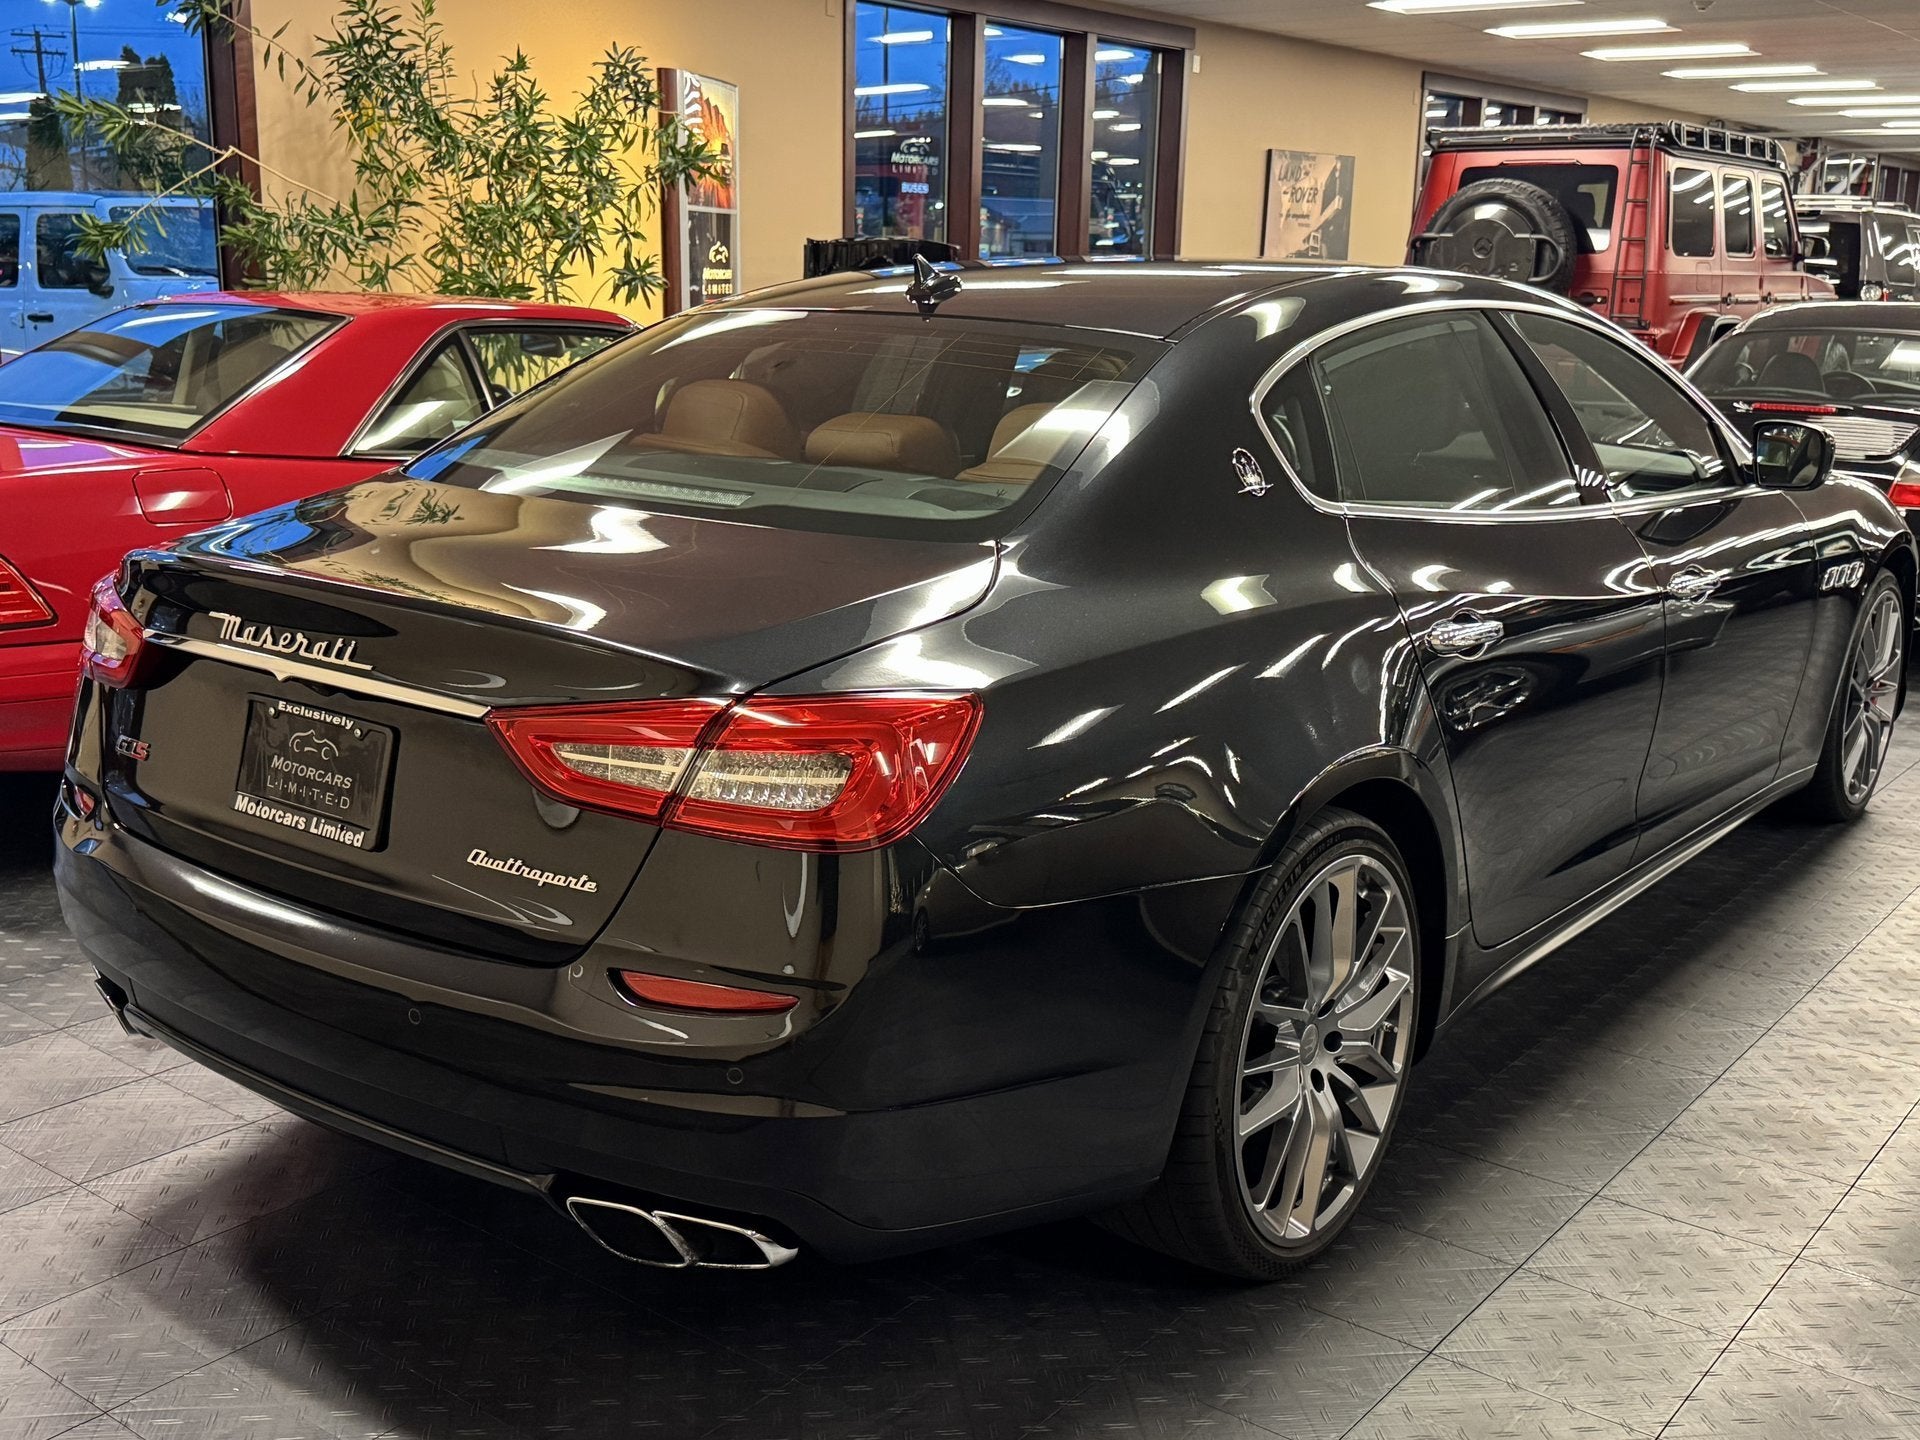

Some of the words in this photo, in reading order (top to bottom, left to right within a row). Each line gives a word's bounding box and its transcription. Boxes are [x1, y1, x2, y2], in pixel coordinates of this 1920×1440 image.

[208, 610, 374, 671] Maserati
[278, 700, 354, 730] Exclusively
[115, 734, 151, 762] GTS
[270, 754, 353, 789] MOTORCARS
[234, 794, 307, 831] Motorcars
[309, 816, 365, 848] Limited
[466, 848, 598, 893] Quattroporte
